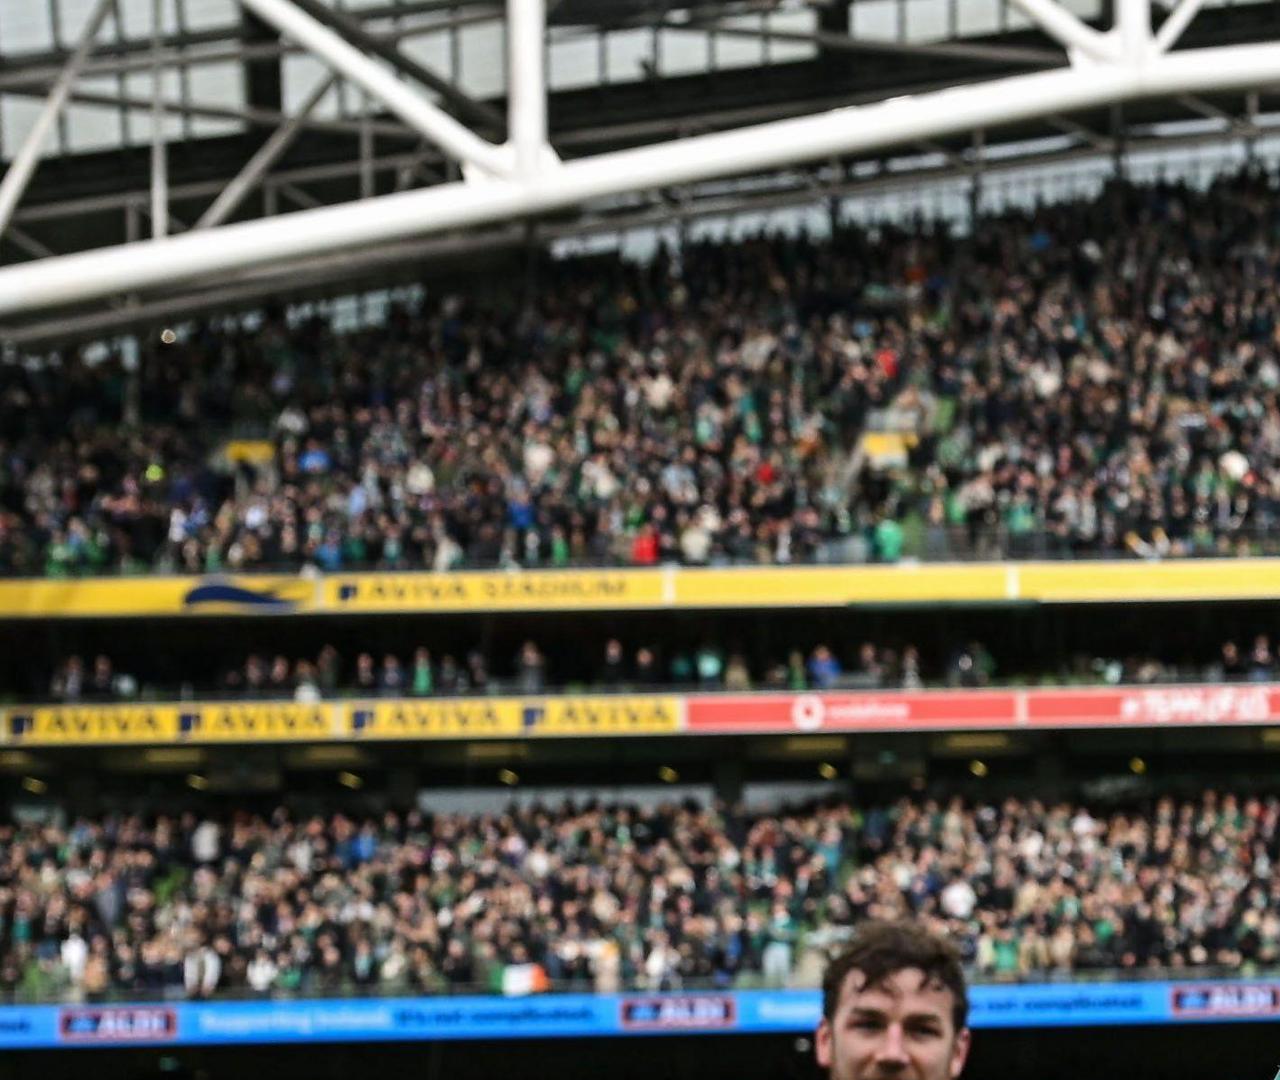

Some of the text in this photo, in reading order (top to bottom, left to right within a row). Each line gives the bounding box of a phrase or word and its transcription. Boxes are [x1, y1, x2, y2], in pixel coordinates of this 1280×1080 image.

[46, 705, 163, 731] AVIVA
[214, 702, 327, 729] AVIVA
[389, 701, 499, 727] AVIVA
[557, 699, 671, 725] AVIVA
[661, 999, 723, 1025] ALDI
[1208, 985, 1271, 1013] ALDI
[98, 1011, 167, 1038] ALDI
